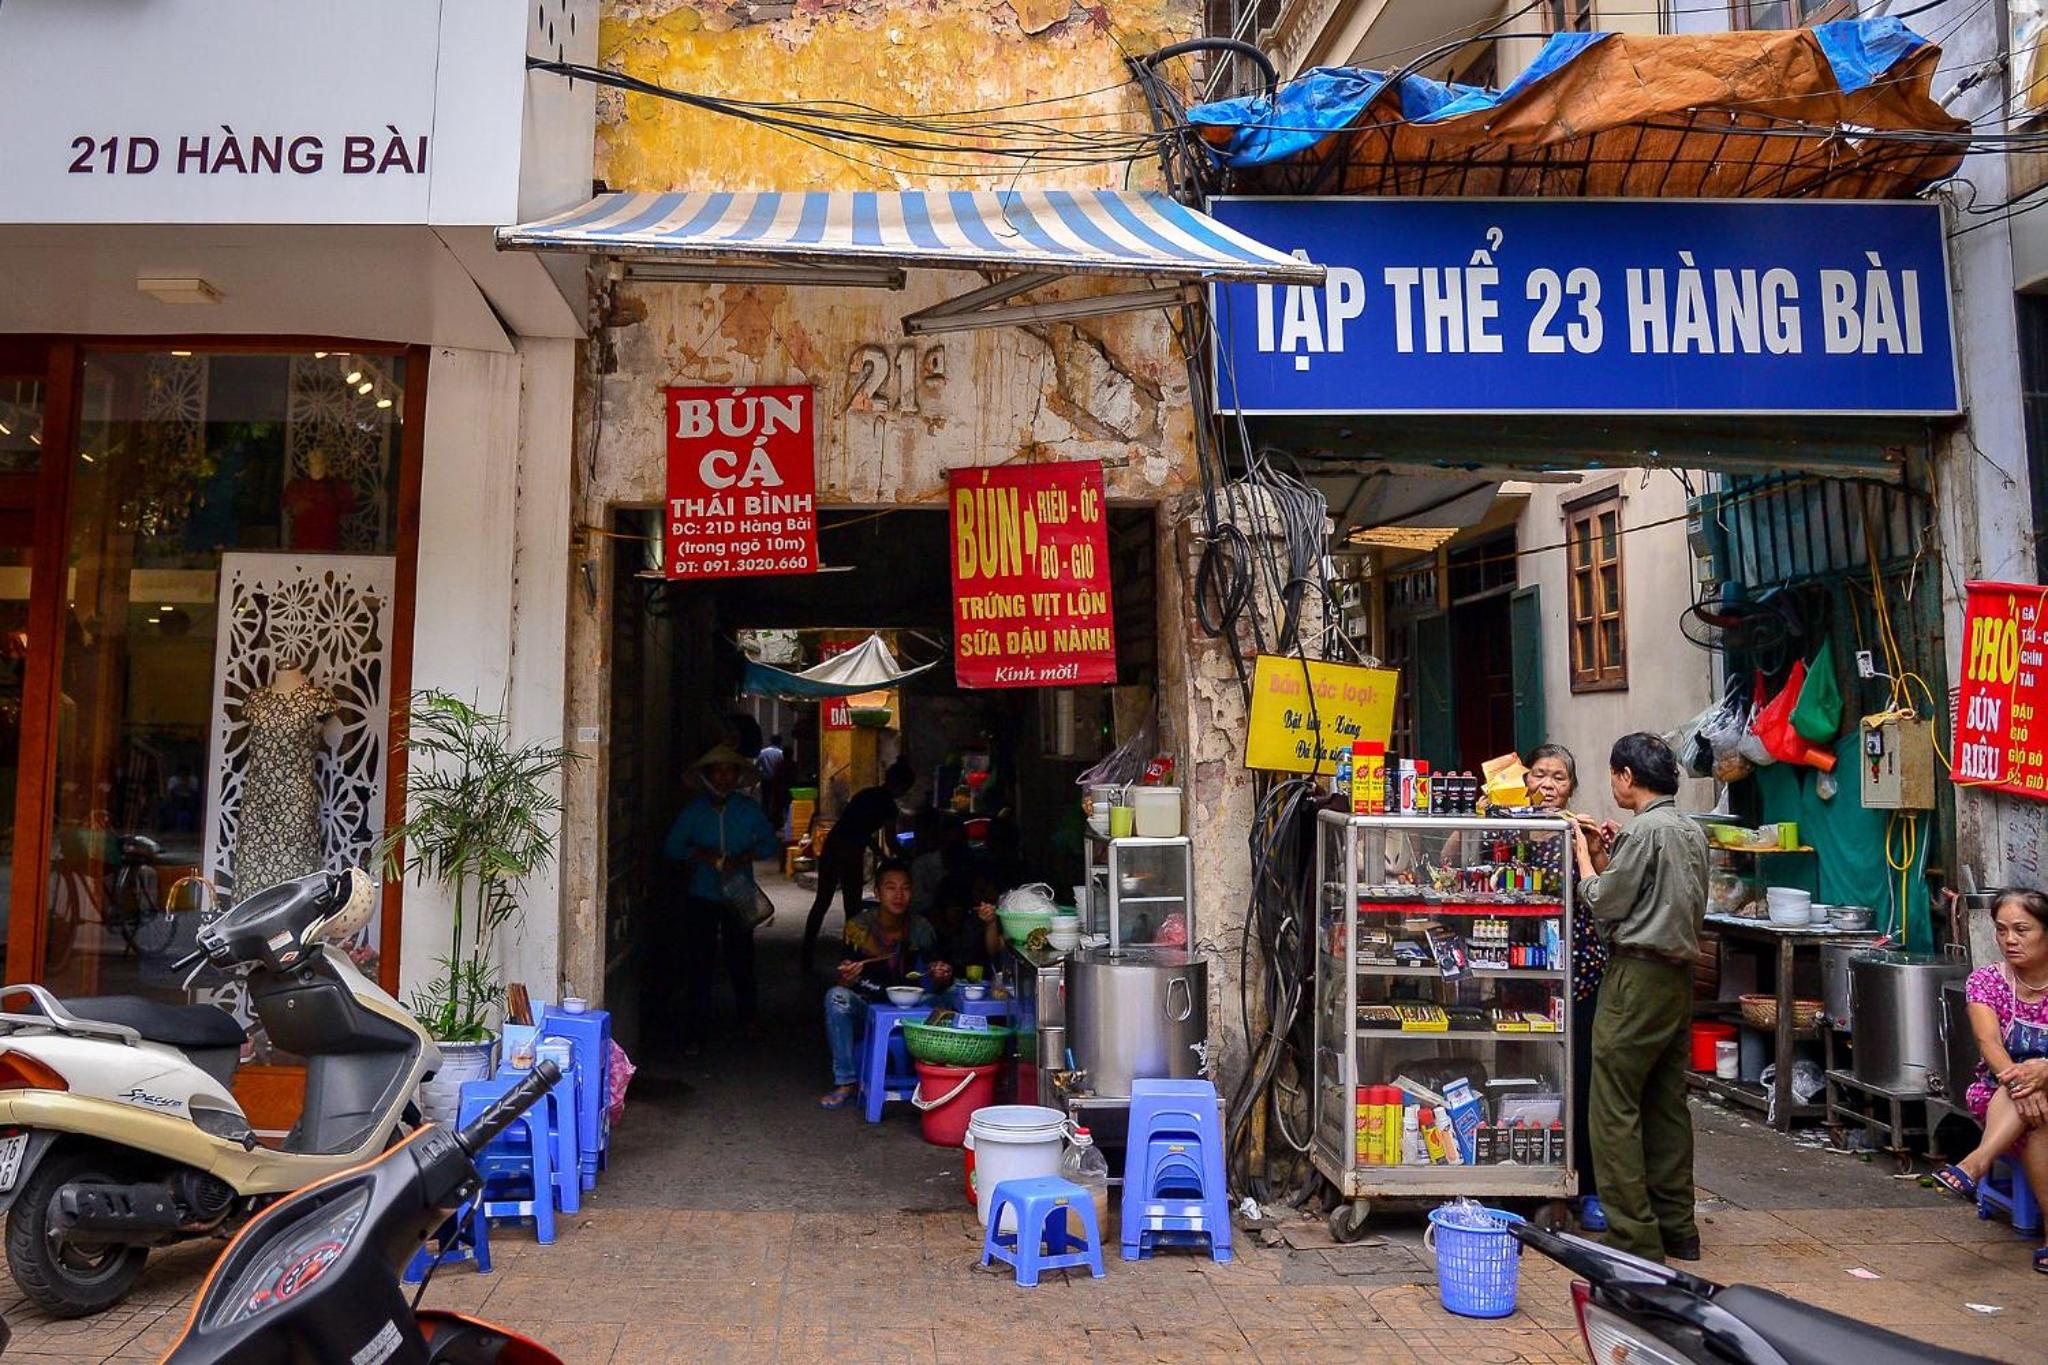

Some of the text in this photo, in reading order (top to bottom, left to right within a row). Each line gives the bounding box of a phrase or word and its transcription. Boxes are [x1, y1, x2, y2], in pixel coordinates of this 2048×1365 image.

[68, 125, 428, 174] 21D HÀNG BÀI
[1256, 227, 1924, 371] TẬP THỂ 23 HÀNG BÀI
[675, 387, 804, 439] BÚN
[699, 436, 784, 489] CÁ
[671, 490, 812, 518] THÁI BÌNH
[1037, 483, 1068, 524] RIÊU
[1080, 476, 1099, 524] ỐC
[671, 518, 812, 536] ĐC: 21D Hàng Bài
[956, 469, 1023, 580] BÚN
[675, 556, 808, 574] ĐT: 091.3020.660
[678, 540, 726, 557] (trong
[766, 537, 806, 552] 10m)
[959, 587, 1107, 621] TRỨNG VỊT LỘN
[960, 624, 1111, 659] SỮA ĐẬU NÀNH
[1968, 592, 2020, 685] PHỞ
[994, 663, 1079, 682] Kính mời!
